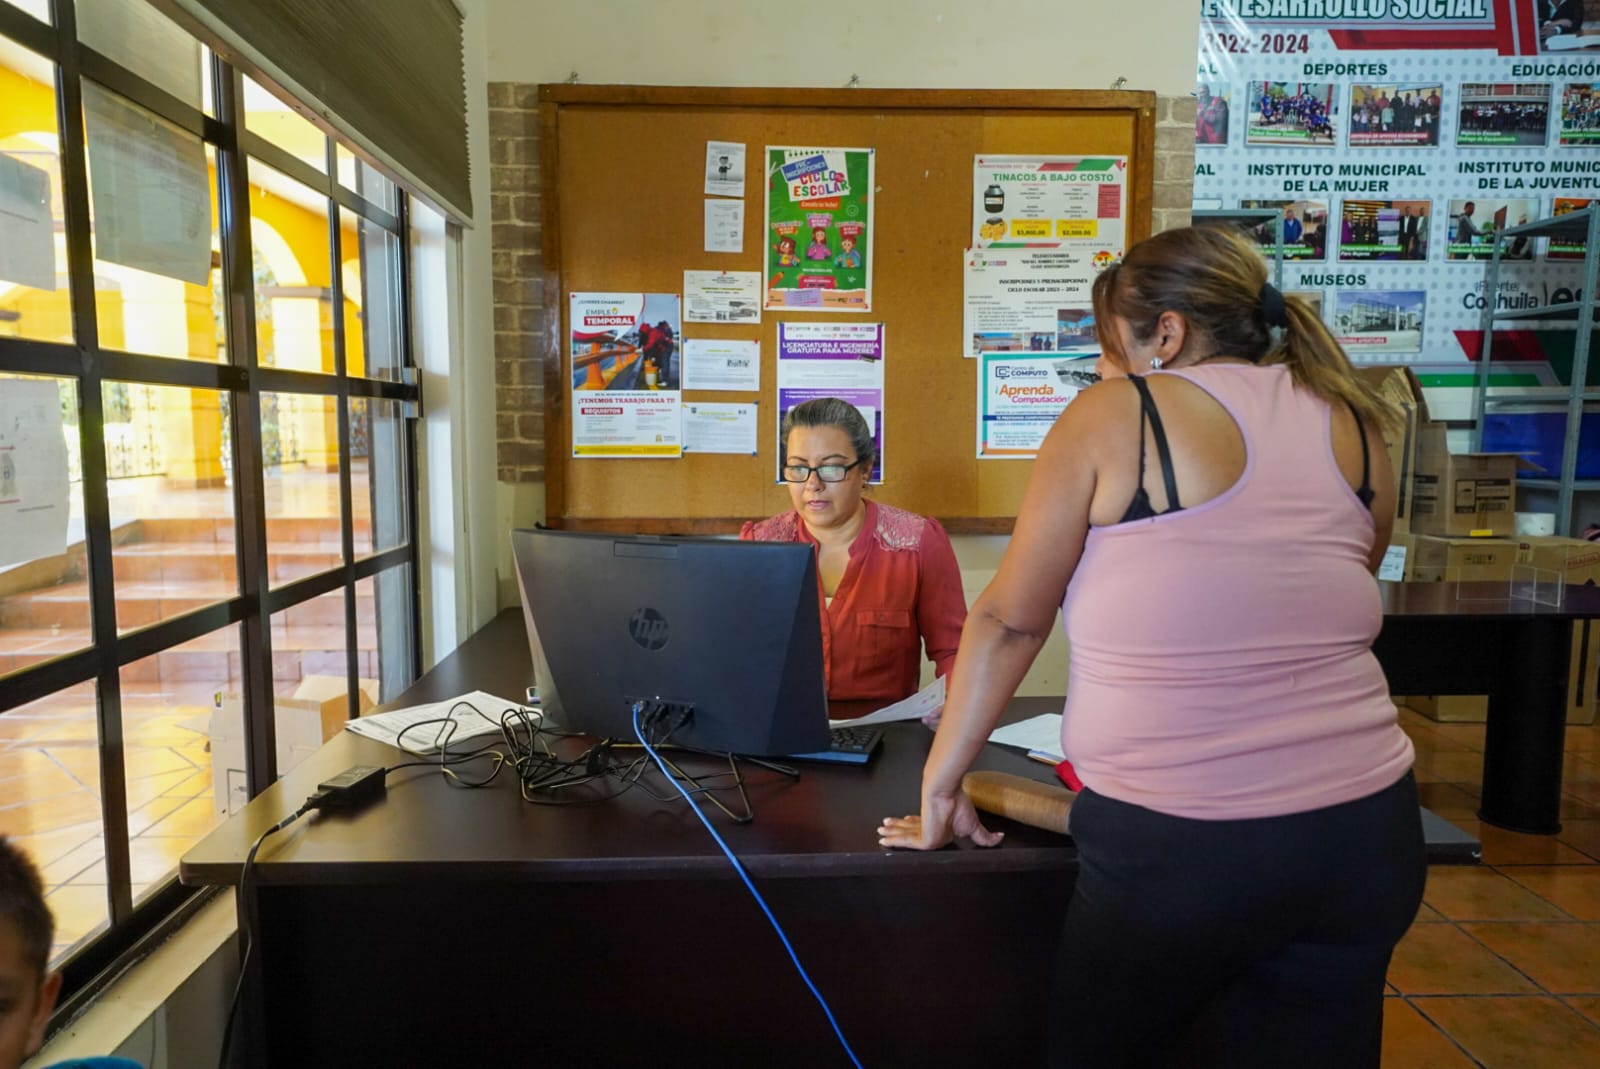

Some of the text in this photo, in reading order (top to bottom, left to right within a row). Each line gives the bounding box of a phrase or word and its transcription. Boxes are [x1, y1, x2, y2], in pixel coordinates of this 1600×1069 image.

[1390, 0, 1487, 19] SOCIAL
[1303, 63, 1388, 76] DEPORTES
[1247, 164, 1426, 176] INSTITUTO MUNICIPAL
[1458, 161, 1546, 173] INSTITUTO
[800, 171, 836, 185] CICLO
[993, 173, 1114, 182] TINACOS A BAJO COSTO
[1478, 178, 1499, 189] DE
[1503, 178, 1524, 189] LA
[794, 180, 849, 197] ESCOLAR
[1283, 181, 1389, 192] DE LA MUJER
[1300, 274, 1367, 286] MUSEOS
[1462, 292, 1538, 310] Cohuila
[587, 317, 633, 325] TEMPORAL
